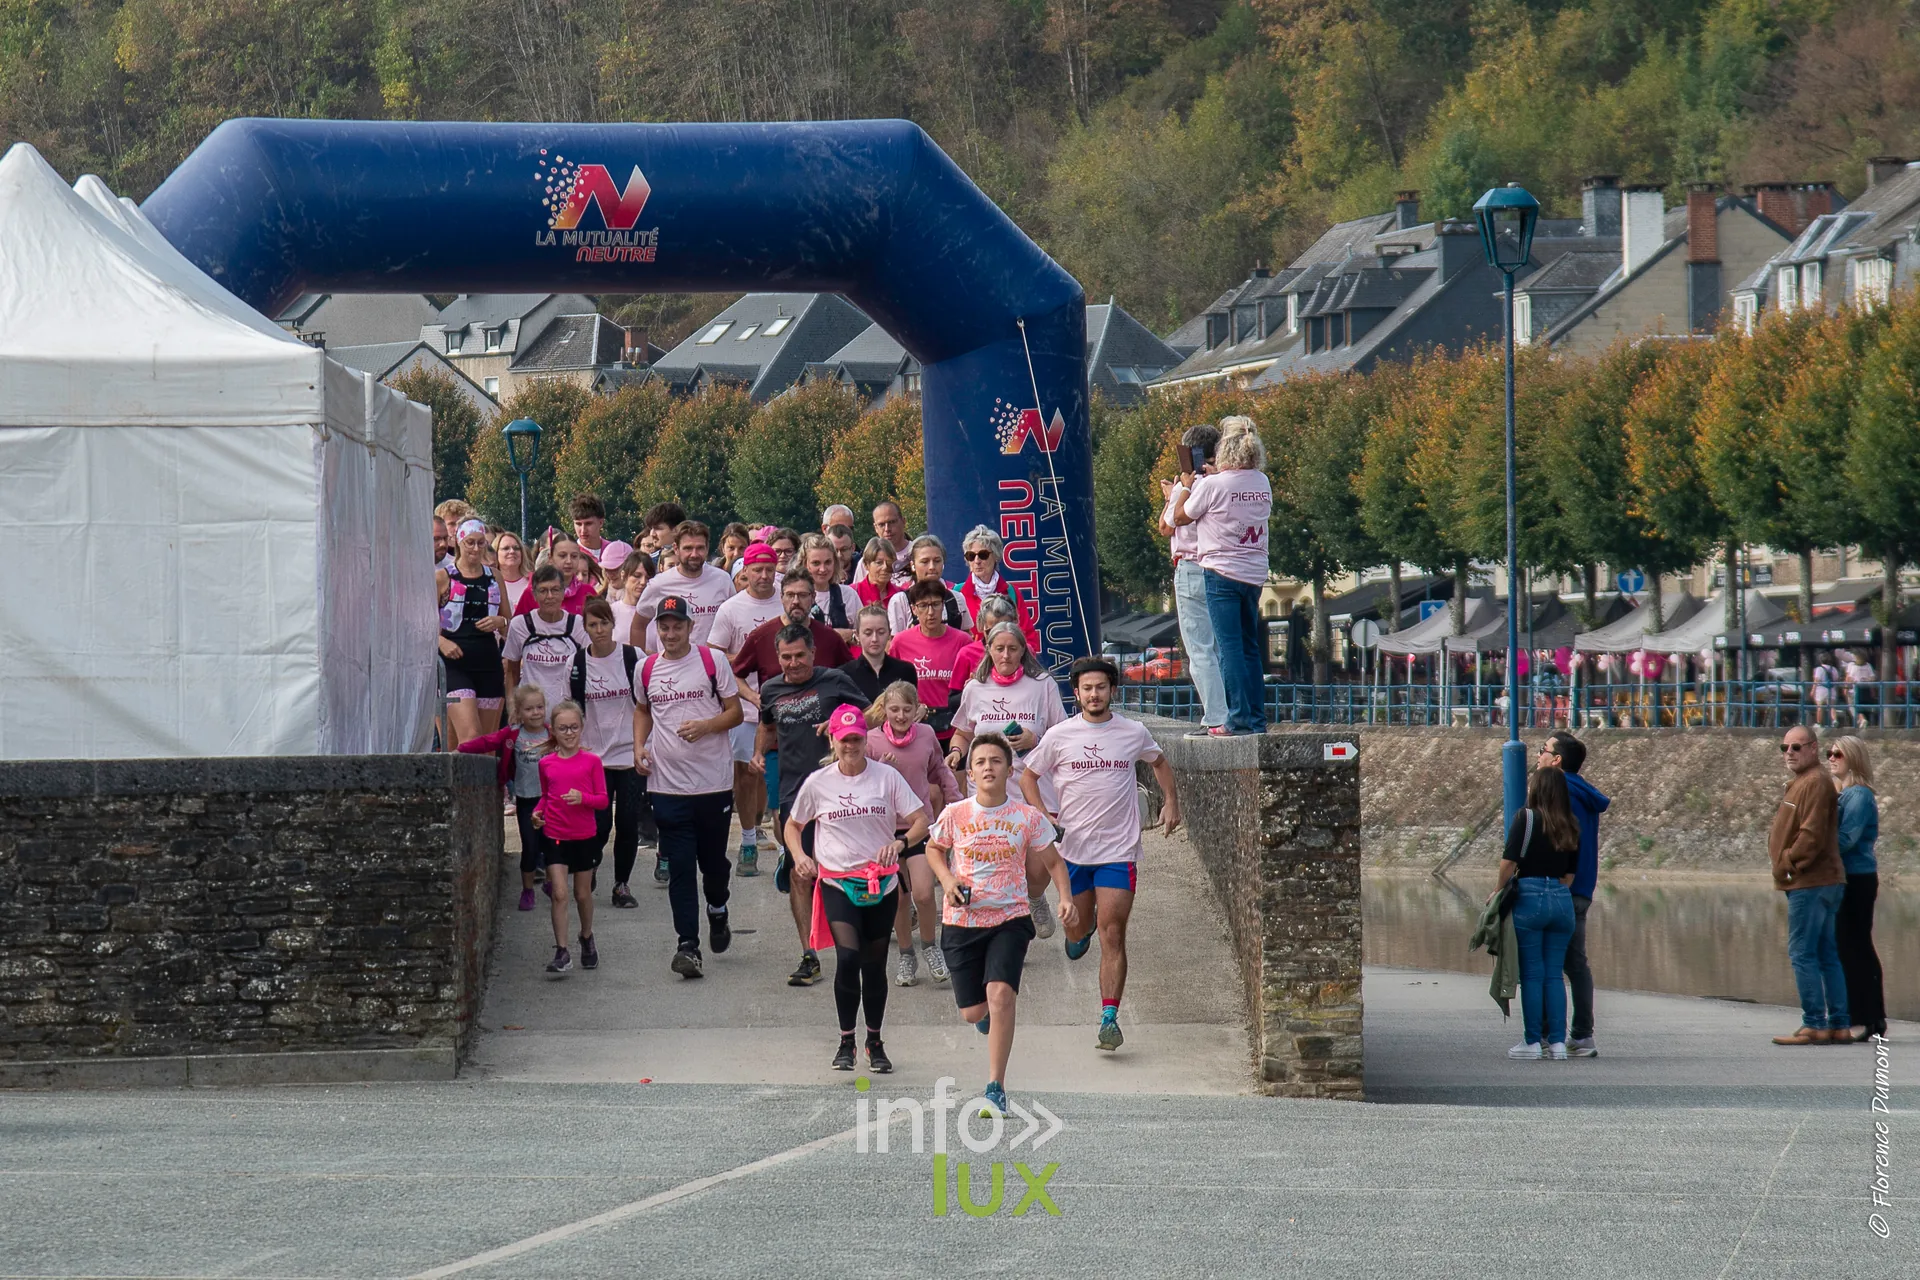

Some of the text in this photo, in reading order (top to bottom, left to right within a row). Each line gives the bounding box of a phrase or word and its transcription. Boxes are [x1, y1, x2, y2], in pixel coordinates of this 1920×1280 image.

[536, 226, 659, 246] LA MUTUALITÉ
[1039, 476, 1066, 521] LA
[585, 689, 617, 700] OUILLON
[686, 690, 704, 699] ROSE
[980, 712, 1036, 722] BOUILLON ROSE
[1071, 760, 1130, 770] BOUILLON ROSE
[828, 806, 869, 821] BOUILLON
[870, 806, 887, 815] ROSE
